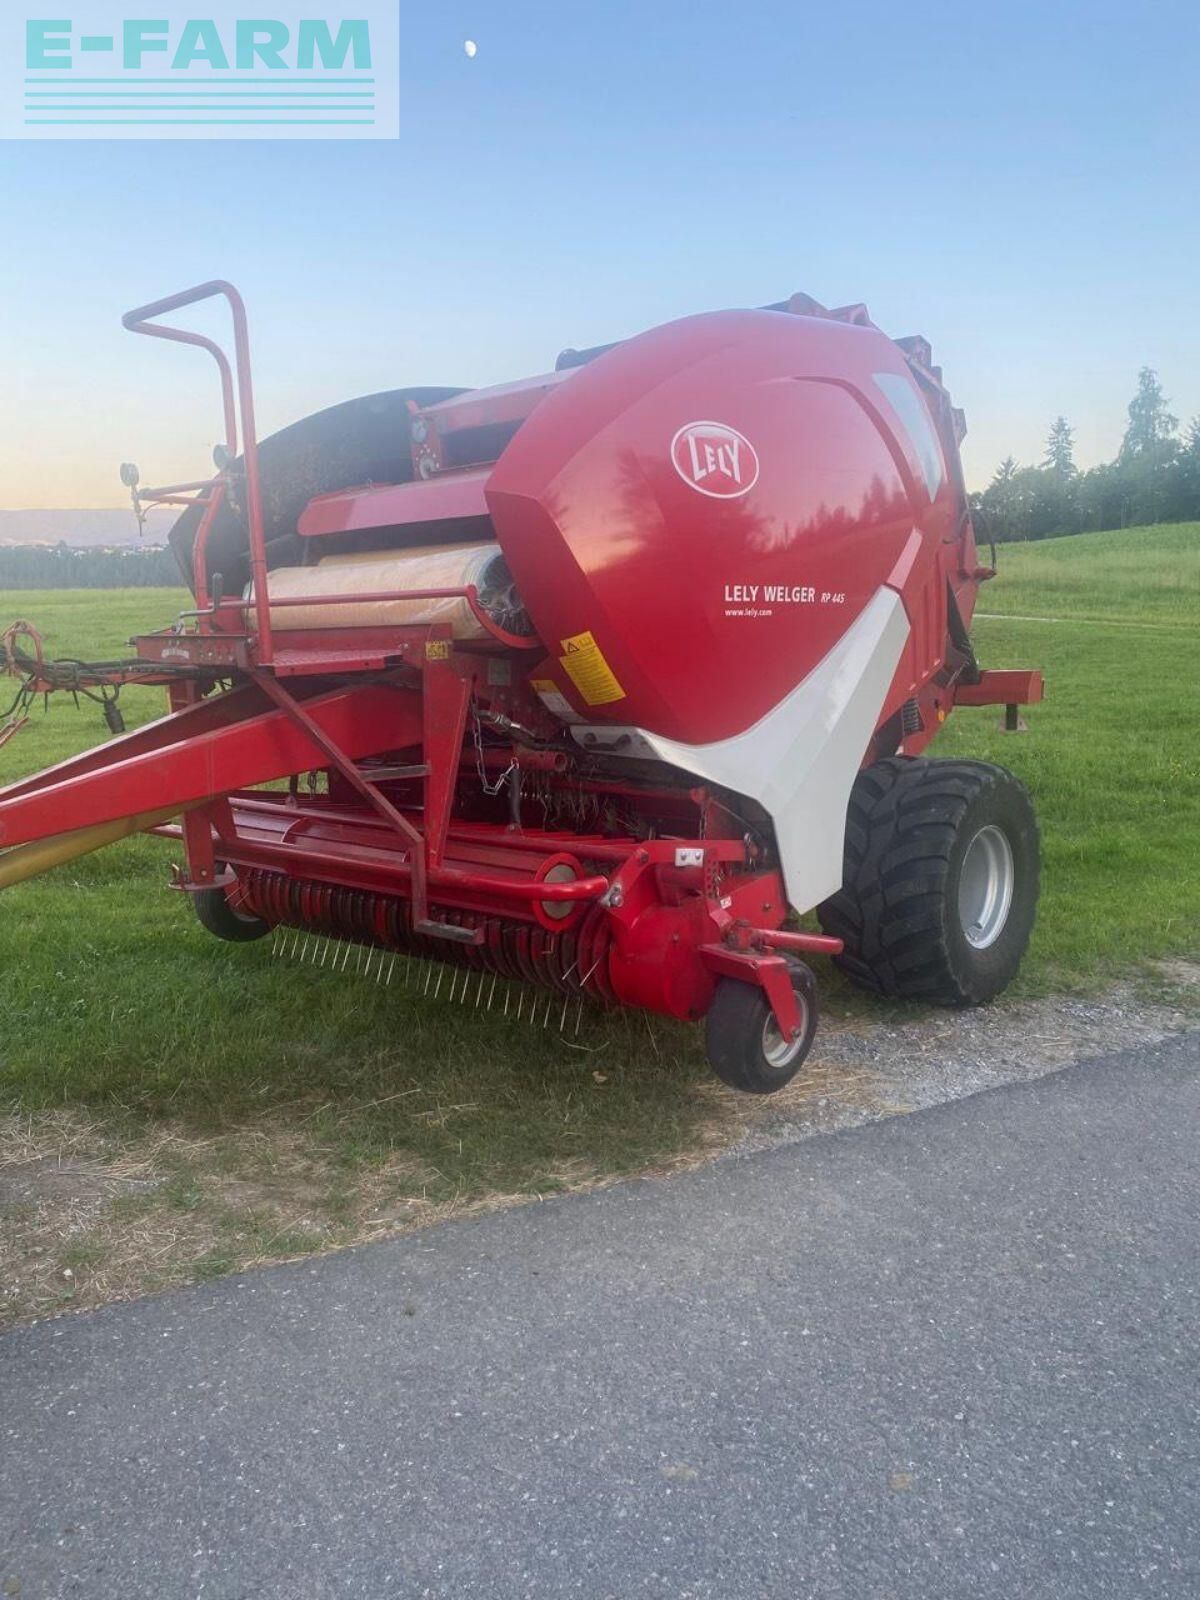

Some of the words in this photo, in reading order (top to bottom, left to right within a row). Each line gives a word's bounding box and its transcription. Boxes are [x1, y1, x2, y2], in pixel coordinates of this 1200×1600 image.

[687, 434, 741, 484] LELY
[724, 585, 759, 602] LELY
[764, 585, 816, 603] WELGER
[820, 592, 831, 603] RP
[832, 593, 846, 604] 445
[724, 608, 772, 618] www.lely.com
